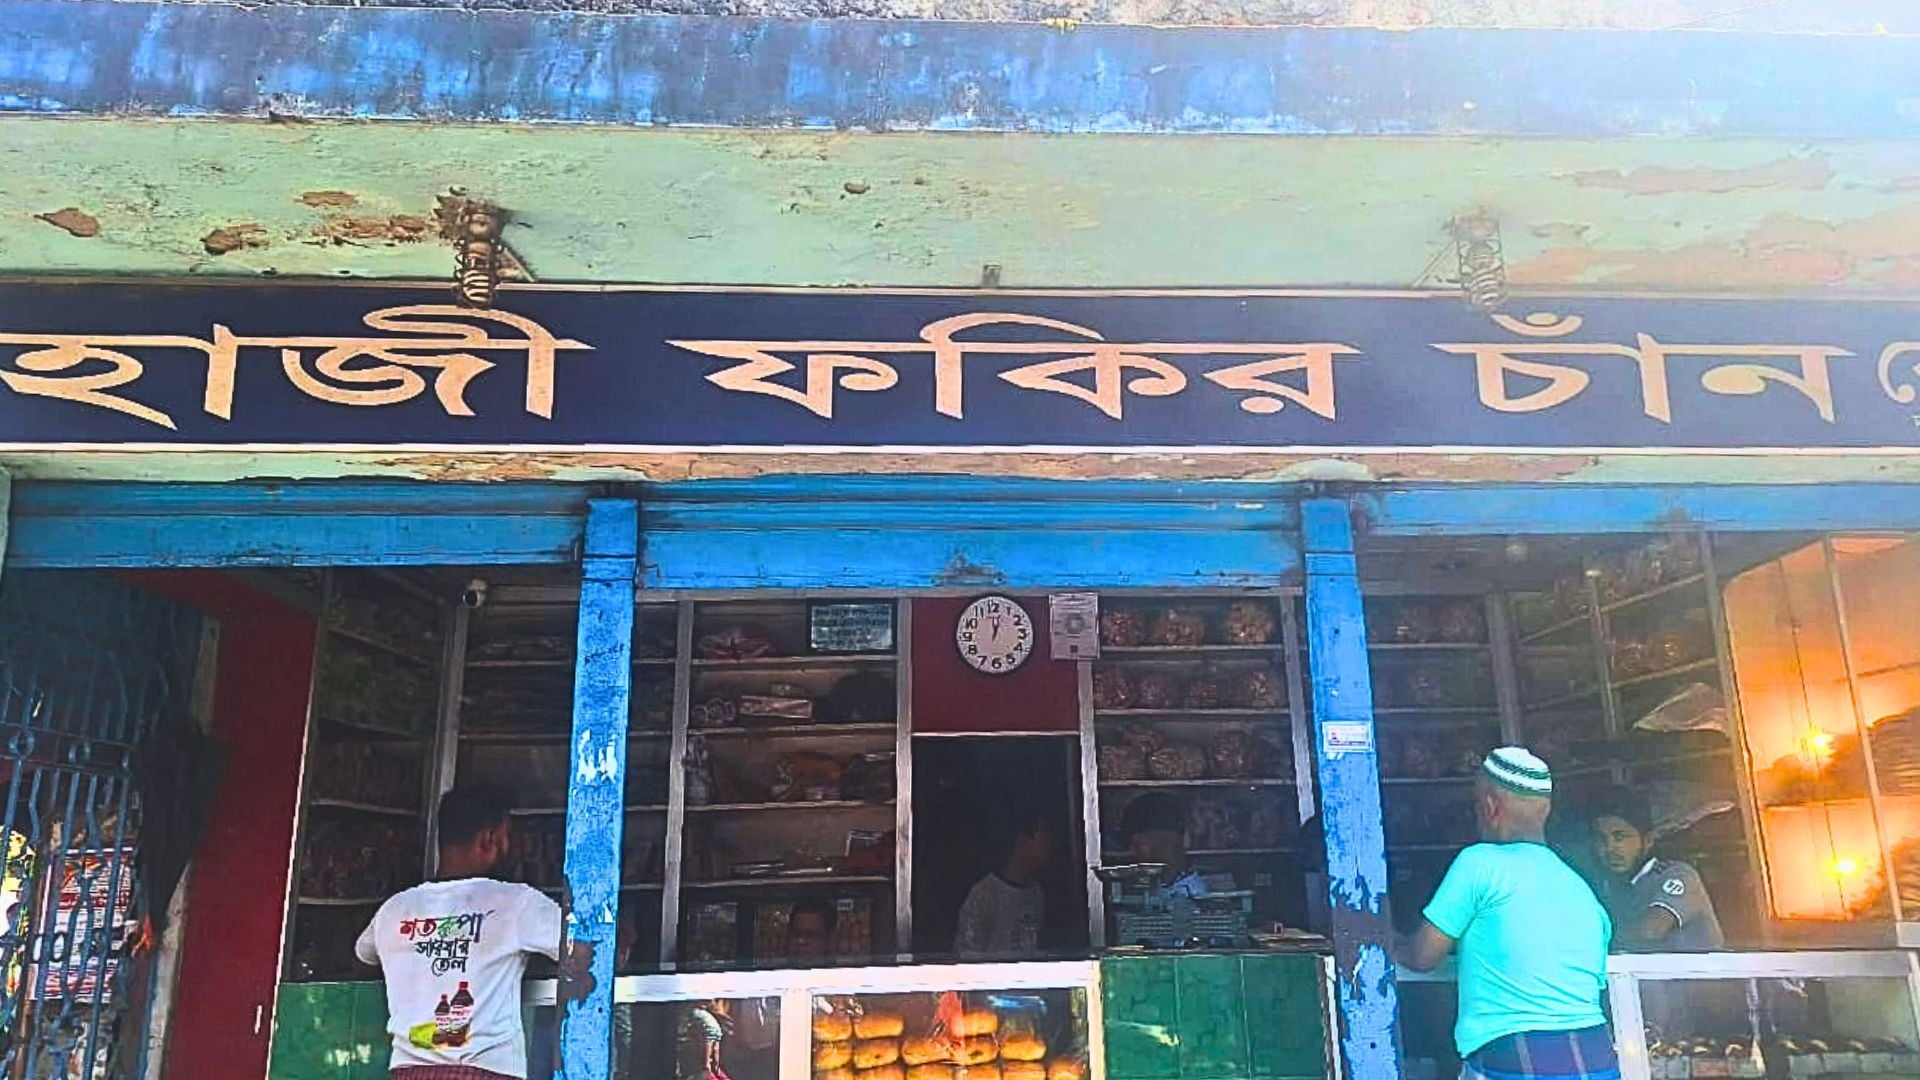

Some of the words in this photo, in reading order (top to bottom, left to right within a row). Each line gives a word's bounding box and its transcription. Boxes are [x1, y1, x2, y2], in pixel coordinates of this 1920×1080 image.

[0, 304, 596, 431] হাজী
[664, 312, 1363, 421] ফকির
[1427, 312, 1858, 424] চাঁন
[988, 602, 1000, 614] 12
[965, 617, 978, 629] 10
[1013, 614, 1023, 626] 2
[962, 631, 973, 642] 9
[1017, 628, 1027, 640] 3
[968, 644, 977, 655] 8
[1013, 642, 1023, 651] 4
[977, 655, 987, 666] 7
[991, 657, 1002, 669] 6
[1005, 653, 1016, 665] 5
[431, 956, 469, 977] তেল
